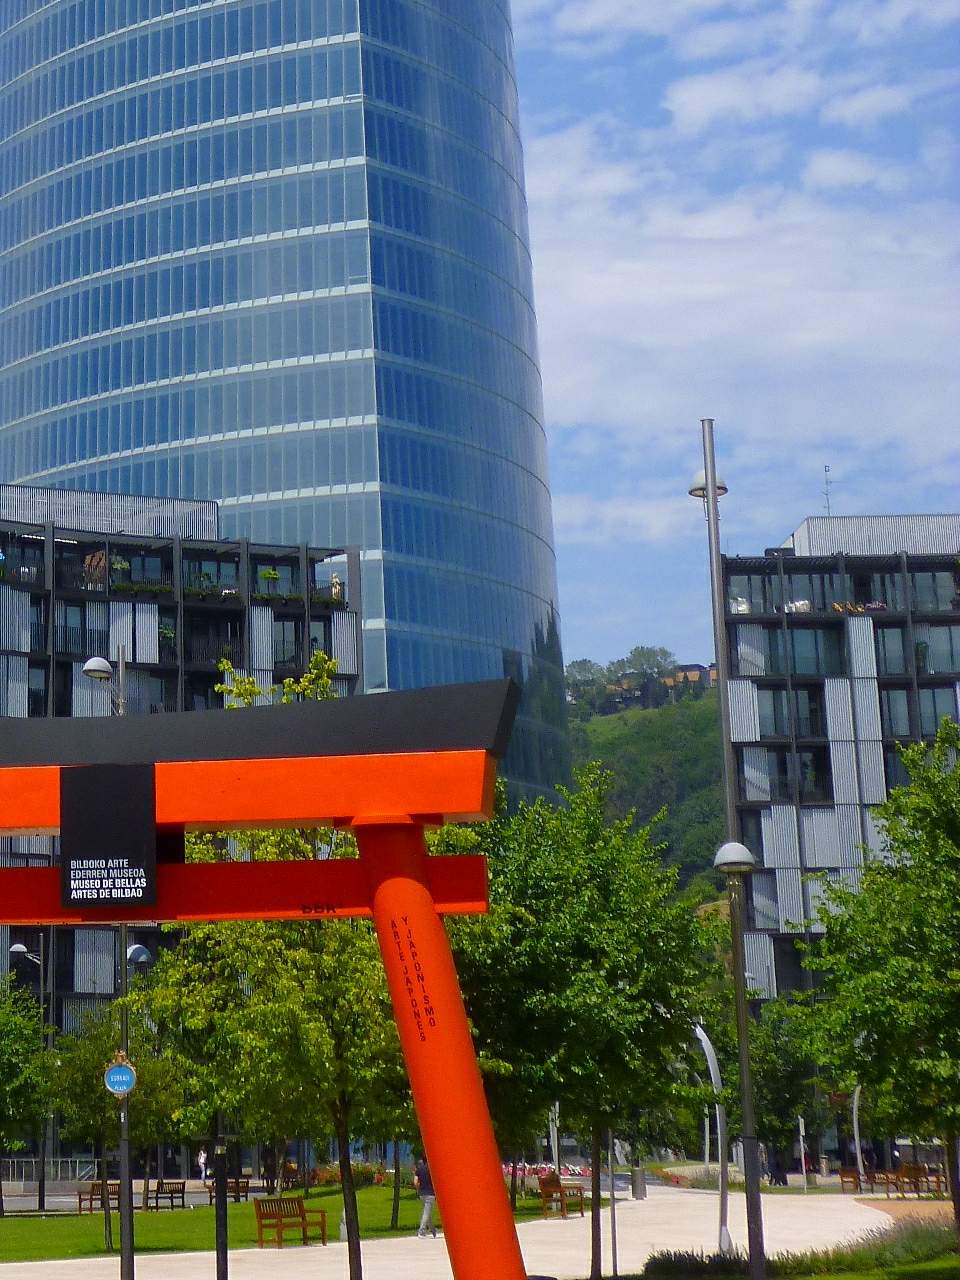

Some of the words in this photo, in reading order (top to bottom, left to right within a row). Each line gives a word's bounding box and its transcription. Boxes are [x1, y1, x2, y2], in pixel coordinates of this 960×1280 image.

[71, 860, 105, 869] BILBOKO
[107, 859, 129, 868] ARTE
[71, 869, 107, 879] EDERREN
[110, 868, 145, 878] MUSEOA
[71, 879, 100, 889] MUSEO
[103, 879, 114, 888] DE
[115, 878, 147, 888] BELLAS
[71, 889, 97, 899] ARTES
[100, 889, 110, 898] DE
[112, 888, 143, 898] BILBAO
[391, 920, 405, 962] ARTE
[407, 929, 436, 1027] JAPONISMO
